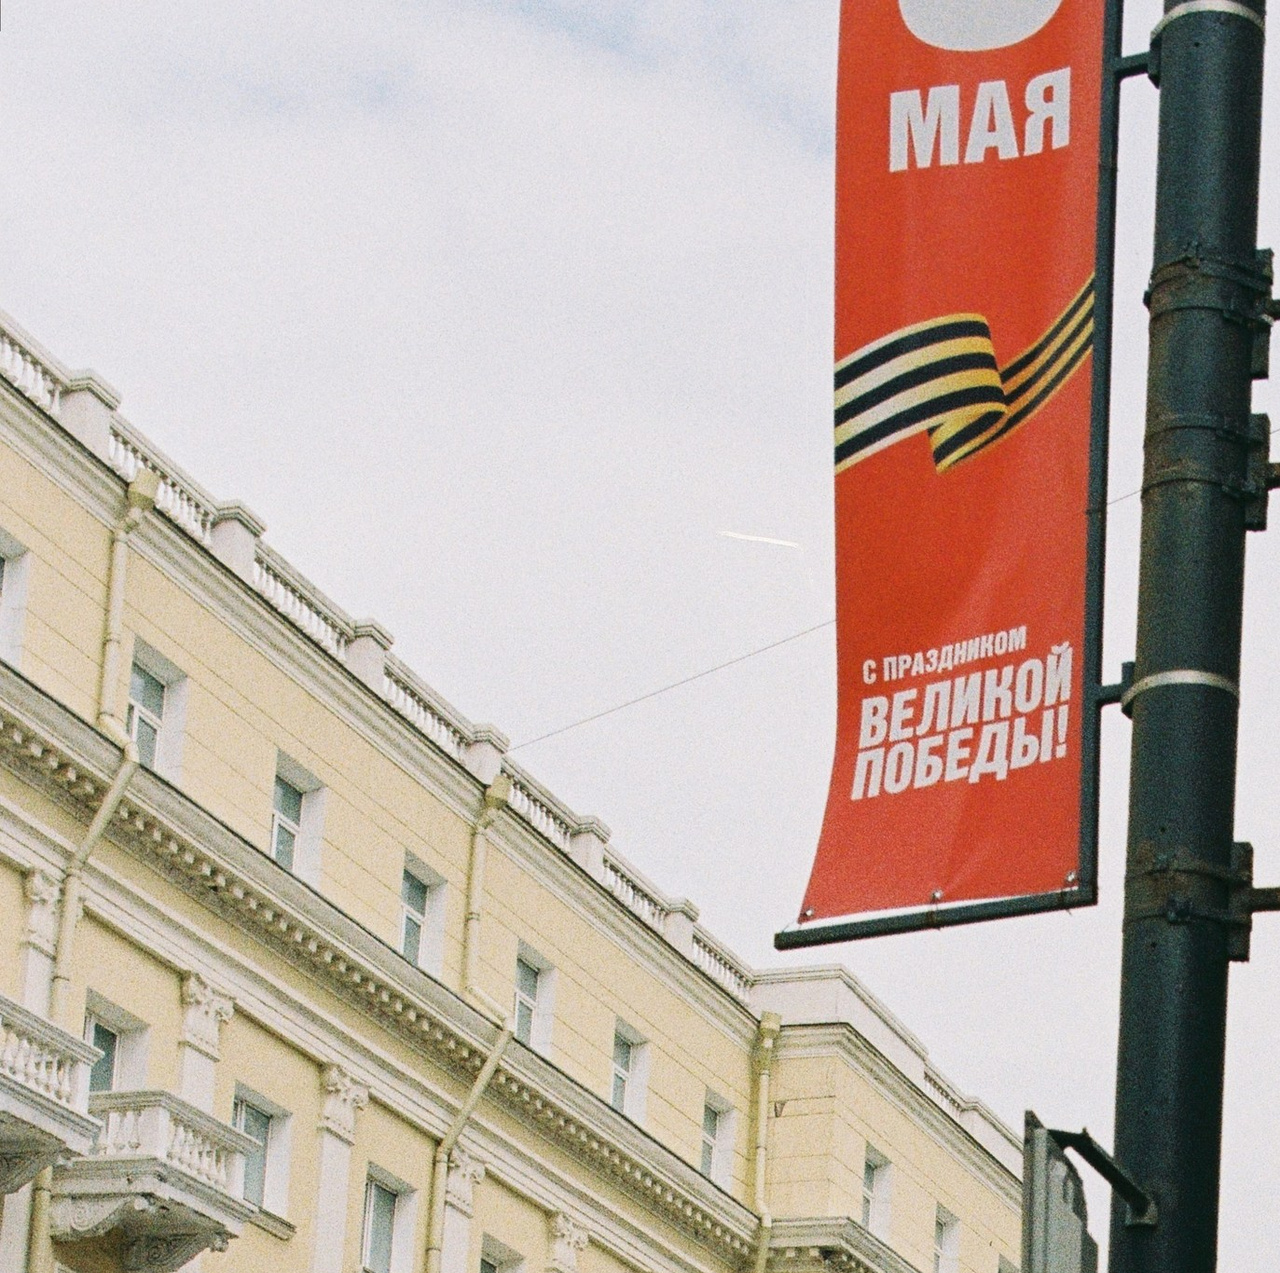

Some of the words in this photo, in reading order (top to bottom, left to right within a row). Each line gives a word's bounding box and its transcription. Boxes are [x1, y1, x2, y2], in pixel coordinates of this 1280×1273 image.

[889, 66, 1071, 173] МАЯ
[858, 641, 1074, 749] ВЕЛИКОЙ
[862, 659, 877, 684] С
[883, 625, 1027, 682] ПРАЗДНИКОМ
[850, 704, 1069, 801] ПОБЕДЫ!
